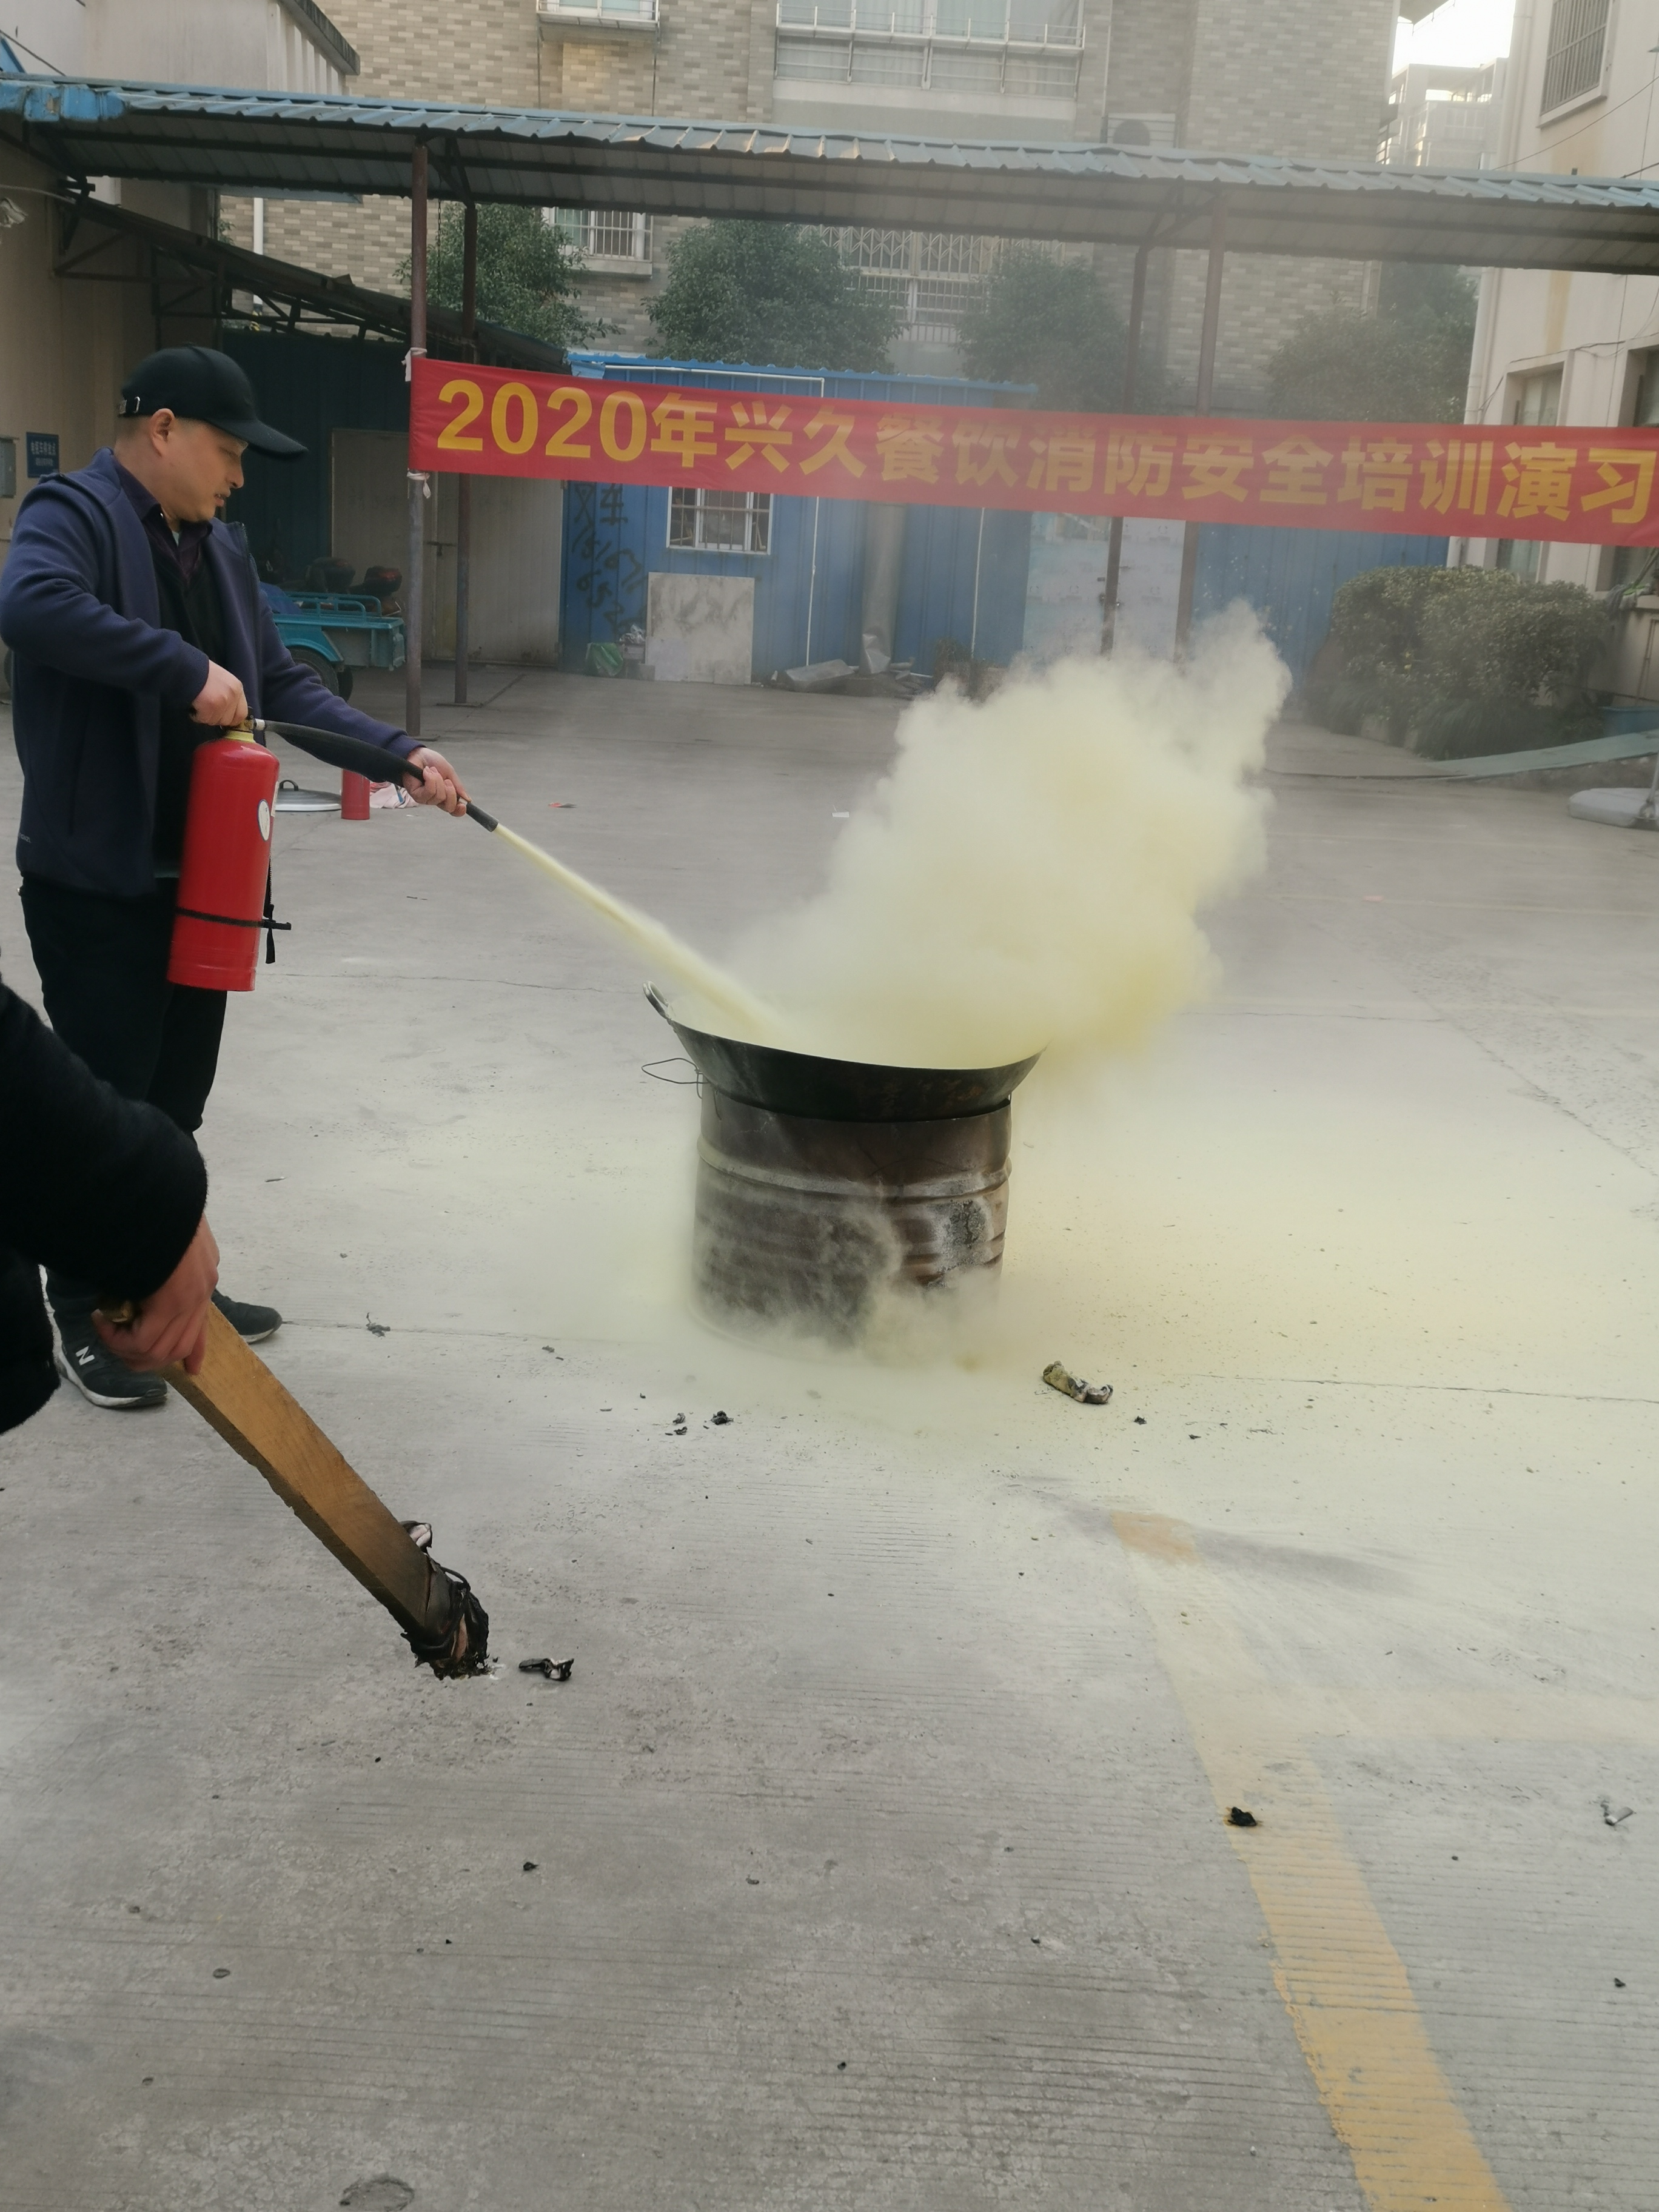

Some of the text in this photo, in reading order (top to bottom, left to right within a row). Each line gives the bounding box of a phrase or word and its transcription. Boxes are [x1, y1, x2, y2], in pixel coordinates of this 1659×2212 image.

[437, 379, 1657, 524] 2020年兴久餐饮消防安全培训演习
